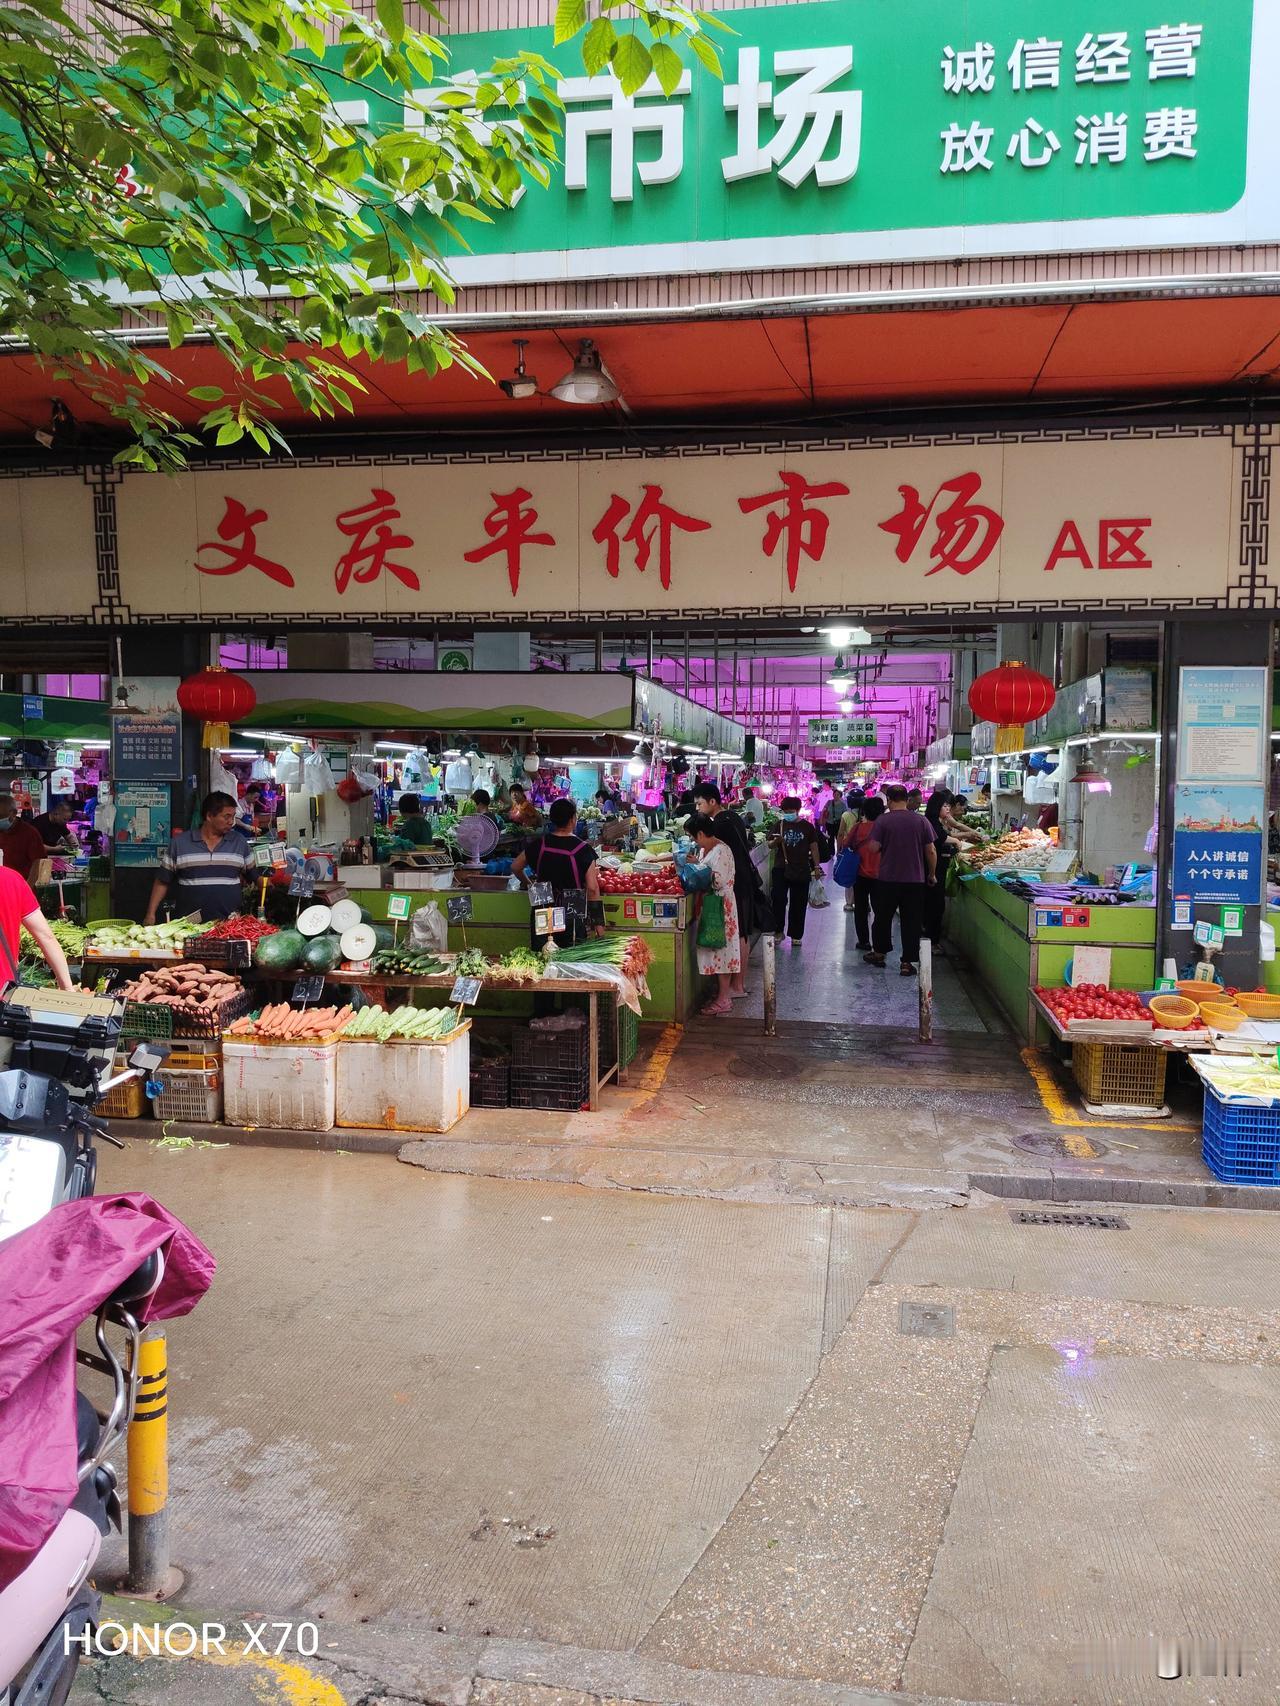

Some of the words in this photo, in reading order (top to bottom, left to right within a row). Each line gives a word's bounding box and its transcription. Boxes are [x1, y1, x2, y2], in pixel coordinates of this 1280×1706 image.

[940, 23, 1203, 95] 诚信经营
[939, 107, 1200, 174] 放心消费
[194, 471, 1004, 598] 文庆平价市场
[1043, 518, 1153, 571] A区
[847, 723, 864, 732] 蔬菜
[812, 734, 829, 742] 冰鲜
[847, 734, 864, 742] 水果
[1187, 850, 1249, 863] 人人讲诚信
[1187, 868, 1249, 880] 个个守承诺
